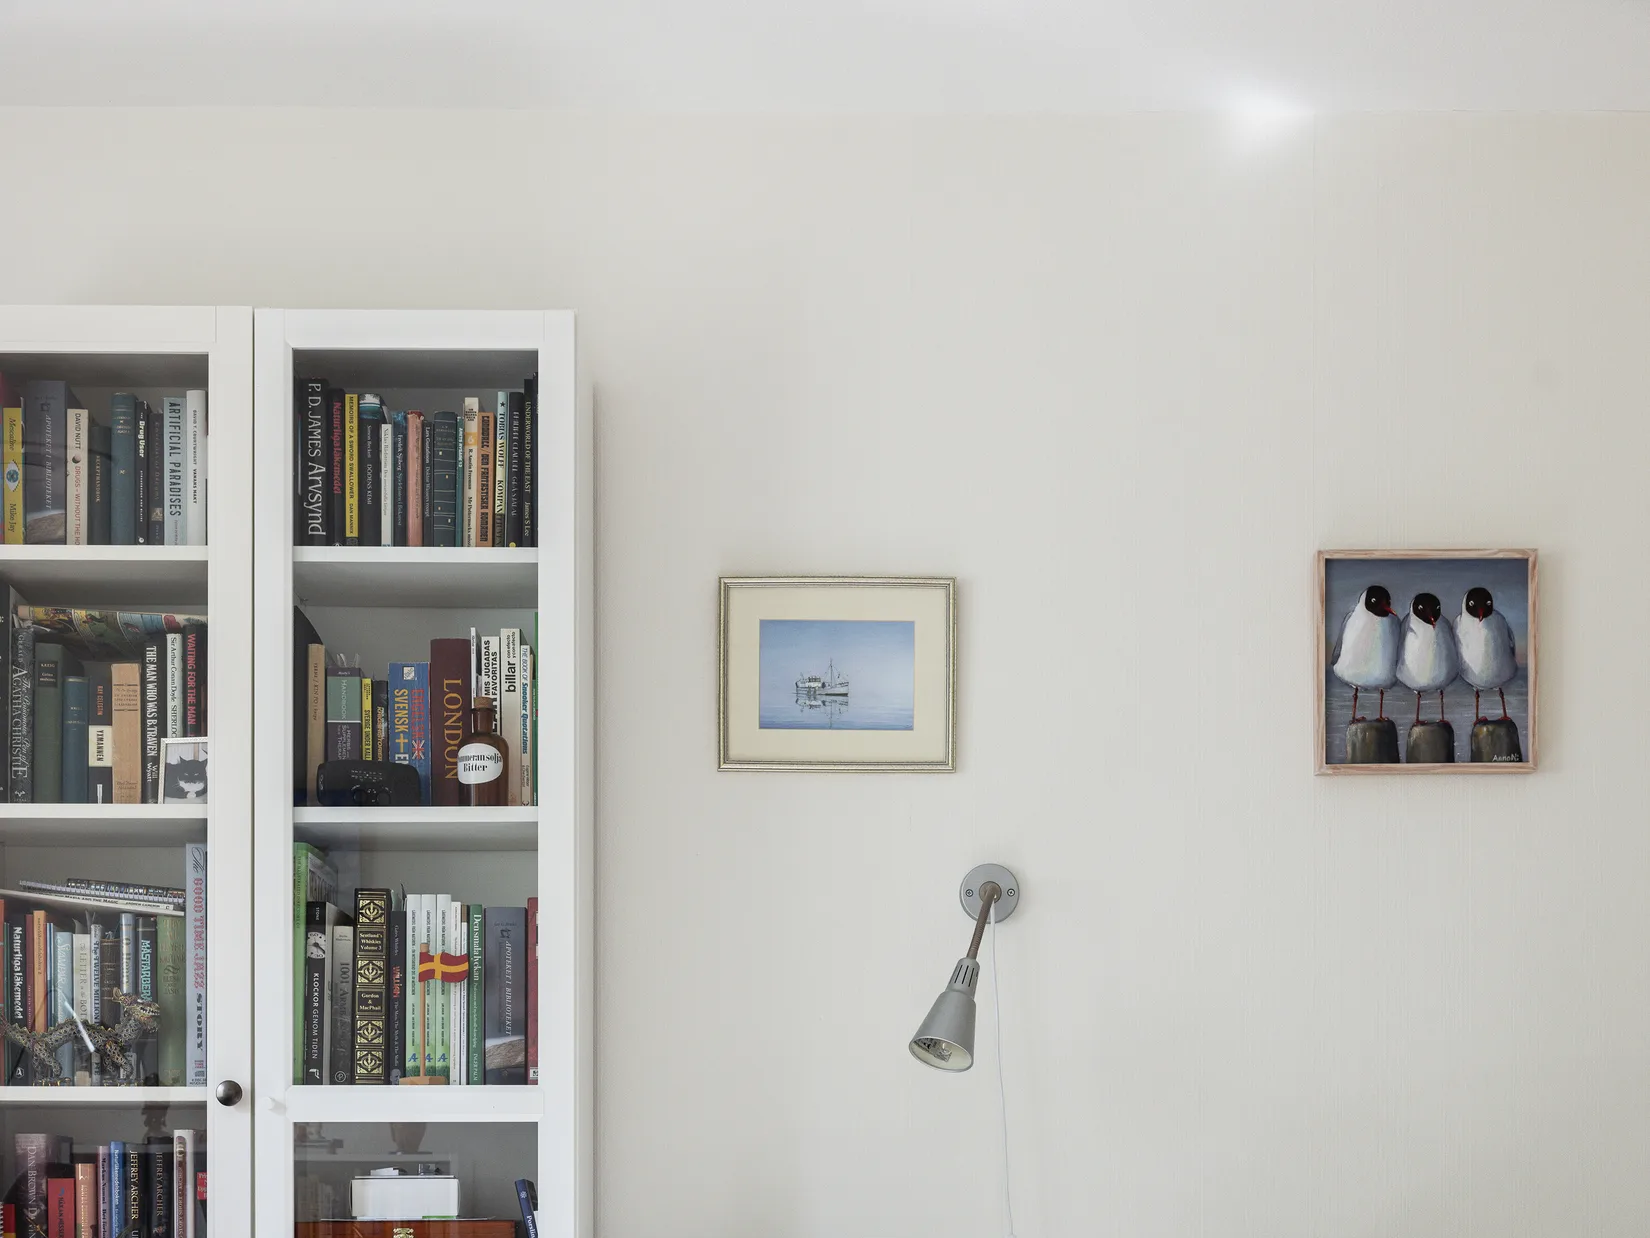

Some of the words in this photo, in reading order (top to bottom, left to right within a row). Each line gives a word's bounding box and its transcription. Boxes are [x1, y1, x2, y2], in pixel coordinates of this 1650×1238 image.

[308, 383, 321, 392] P.
[308, 396, 320, 408] D.
[169, 402, 181, 457] ARTIFICIAL
[308, 411, 321, 456] JAMES
[349, 426, 354, 434] OF
[481, 454, 489, 466] DEN
[525, 450, 531, 460] OF
[169, 461, 181, 516] PARADISES
[304, 462, 326, 535] Arvsynd
[480, 467, 489, 510] FANTASTISKA
[8, 522, 16, 532] Jay
[480, 512, 488, 542] ROMANEN
[147, 646, 157, 663] THE
[187, 634, 196, 670] WAITING
[147, 664, 157, 682] MAN
[188, 671, 196, 688] FOR
[505, 660, 516, 693] billar
[12, 665, 28, 716] AGATHA
[147, 683, 157, 701] WHO
[169, 686, 177, 702] Doyle
[188, 690, 196, 705] THE
[22, 695, 30, 735] Poisonous
[147, 702, 157, 718] WAS
[188, 706, 196, 724] MAN
[394, 689, 409, 733] SVENSK
[411, 688, 425, 738] ENGELSK
[444, 678, 462, 779] LONDON
[12, 719, 28, 779] CHRISTIE
[22, 738, 30, 753] Pen
[96, 730, 104, 762] YXMANNEN
[463, 763, 488, 773] Bitter
[190, 847, 205, 873] The
[194, 877, 204, 913] GOOD
[12, 926, 22, 971] Naturliga
[194, 915, 205, 951] TIME
[473, 932, 481, 955] smala
[79, 952, 87, 984] LETTER
[194, 953, 205, 989] JAZZ
[340, 961, 350, 985] 1001
[470, 955, 482, 981] lyckan
[14, 973, 23, 1019] läkemedel
[27, 1146, 37, 1167] DAN
[130, 1150, 138, 1184] JEFFREY
[28, 1170, 37, 1204] BROWN
